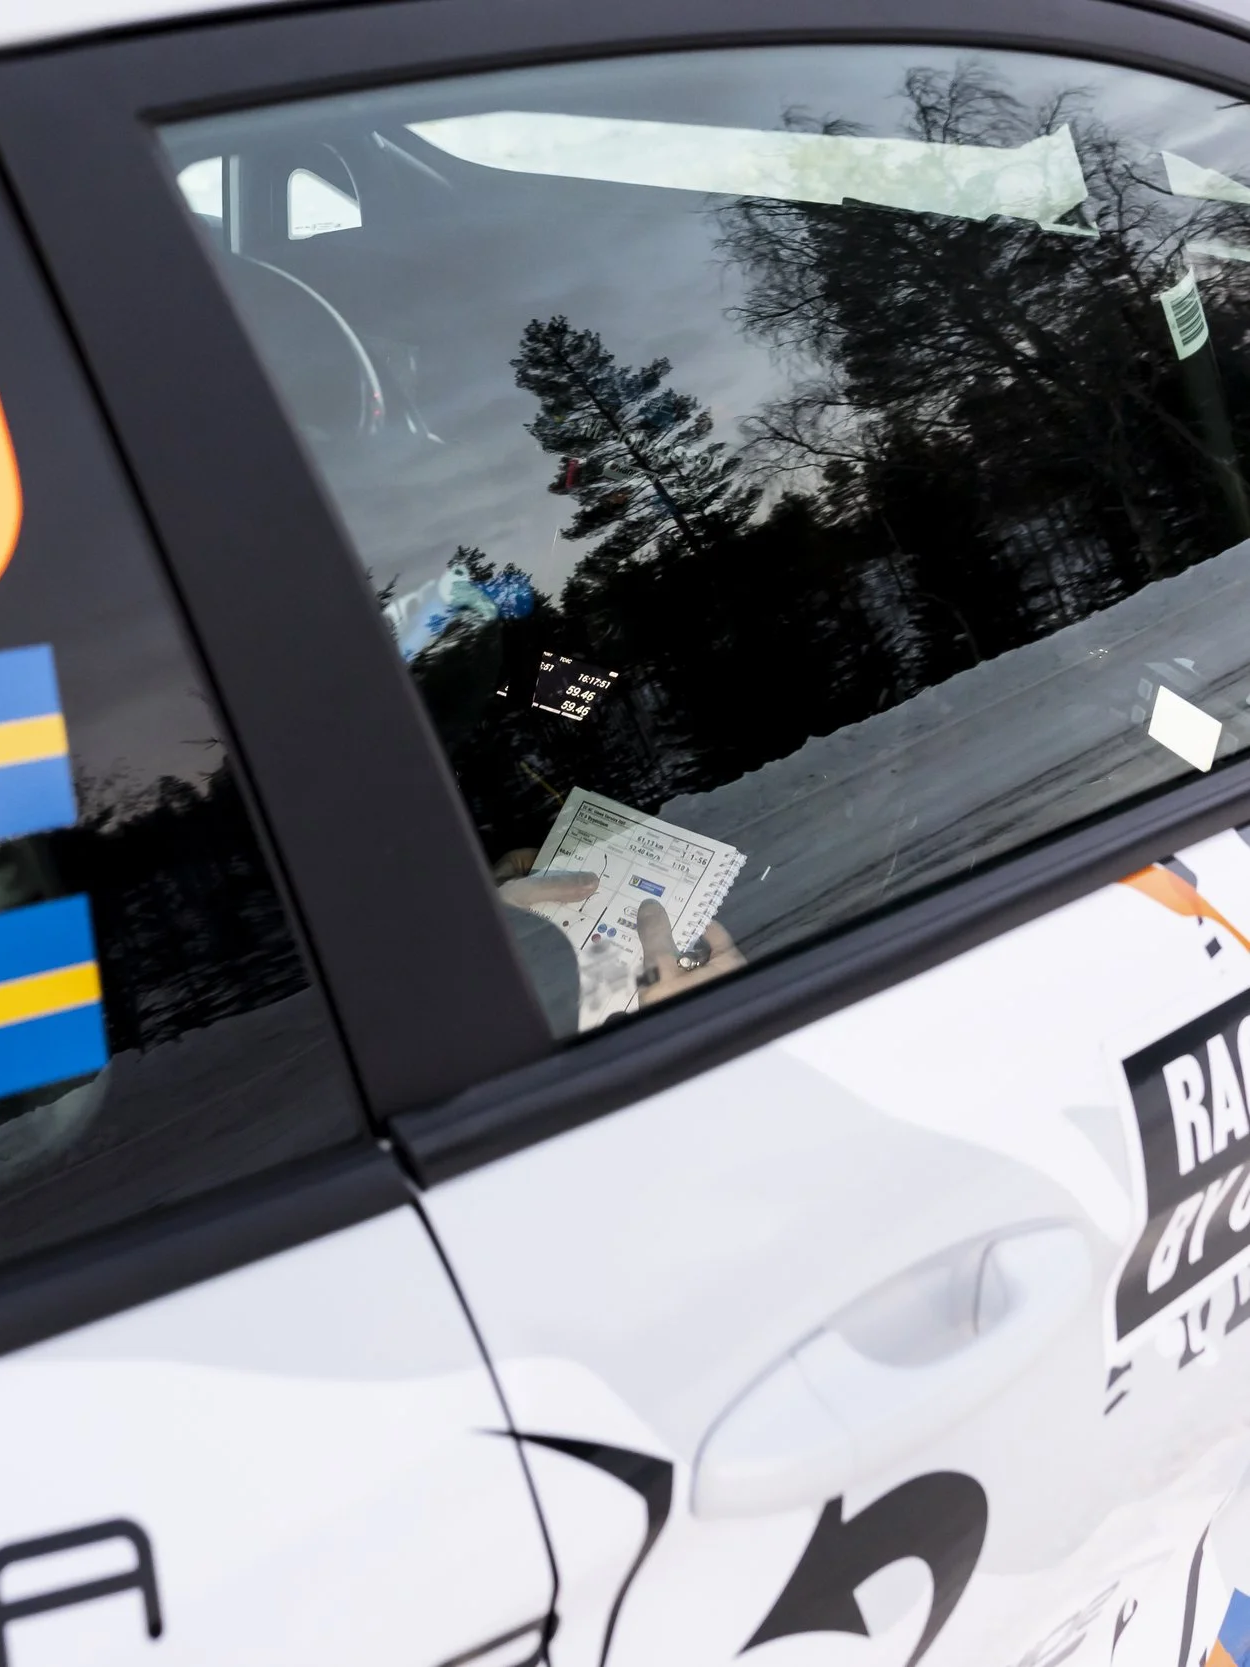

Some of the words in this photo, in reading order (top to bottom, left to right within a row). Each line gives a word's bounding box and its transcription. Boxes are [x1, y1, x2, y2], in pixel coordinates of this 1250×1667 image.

[578, 673, 611, 689] 16:17:51
[565, 685, 596, 701] 59.46
[560, 700, 591, 716] 59.46
